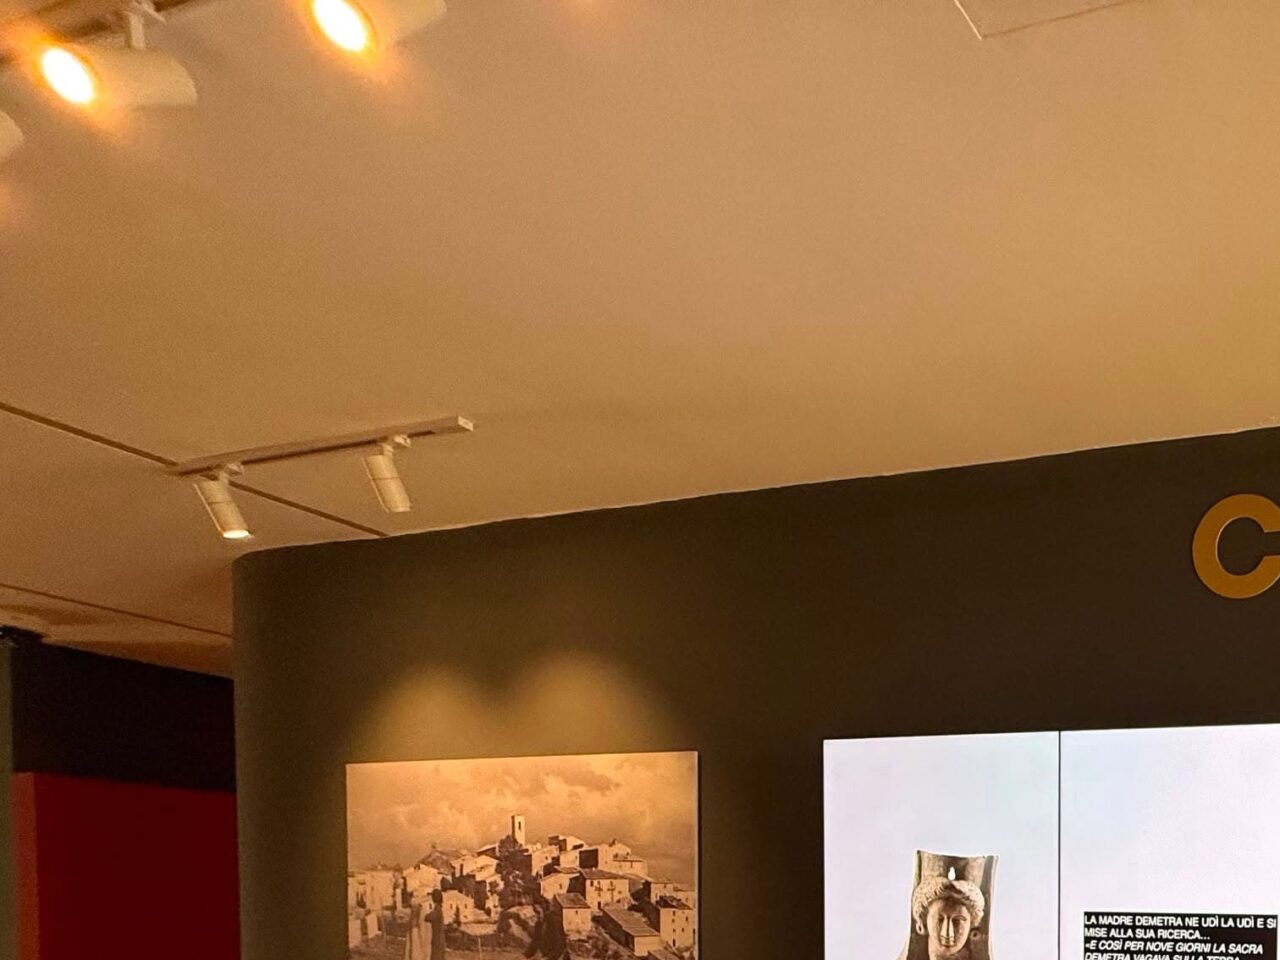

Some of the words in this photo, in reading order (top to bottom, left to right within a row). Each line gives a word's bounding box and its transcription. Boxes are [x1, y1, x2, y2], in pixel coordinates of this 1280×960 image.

[1084, 915, 1097, 925] LA
[1099, 915, 1133, 926] MADRE
[1135, 916, 1182, 927] DEMETRA
[1185, 917, 1199, 927] NE
[1202, 915, 1219, 928] UDÌ
[1221, 918, 1235, 928] LA
[1237, 915, 1254, 928] UDÌ
[1257, 918, 1264, 928] E
[1266, 918, 1276, 929] SI
[1084, 927, 1108, 937] MISE
[1109, 928, 1133, 938] ALLA
[1135, 929, 1155, 939] SUA
[1098, 938, 1122, 950] COSÌ
[1124, 941, 1144, 951] PER
[1146, 942, 1174, 952] NOVE
[1175, 942, 1211, 953] GIORNI
[1212, 943, 1226, 953] LA
[1228, 944, 1263, 955] SACRA
